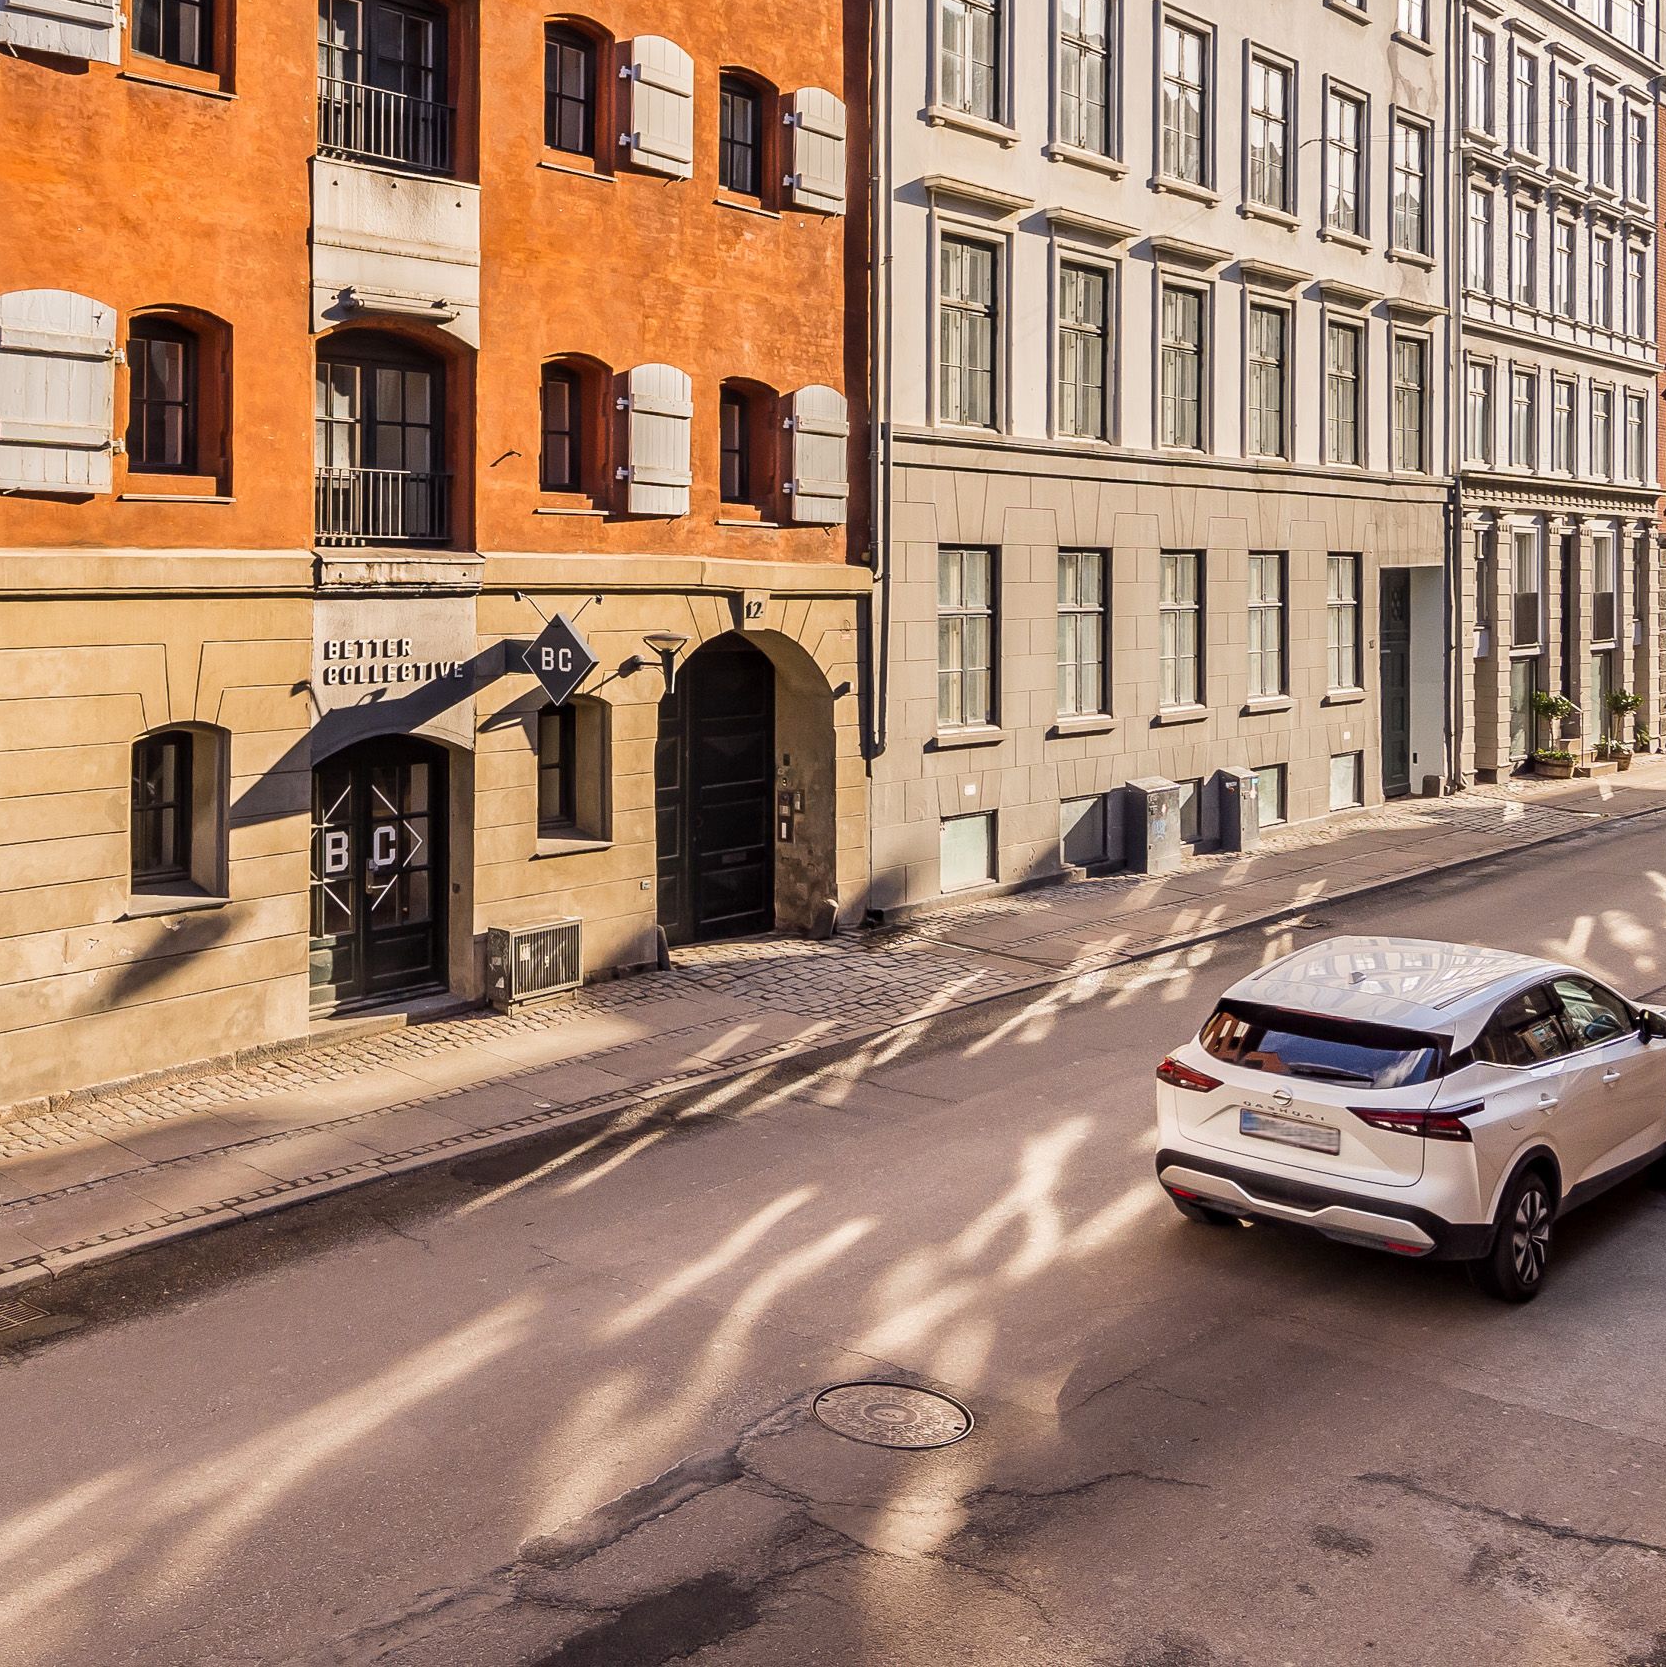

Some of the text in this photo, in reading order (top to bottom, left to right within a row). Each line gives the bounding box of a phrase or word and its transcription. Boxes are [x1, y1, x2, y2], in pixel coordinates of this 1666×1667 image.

[327, 637, 413, 659] BETTER
[541, 646, 572, 673] BC
[327, 660, 465, 686] COLLECTIVE
[1242, 1100, 1325, 1122] QASHQAI
